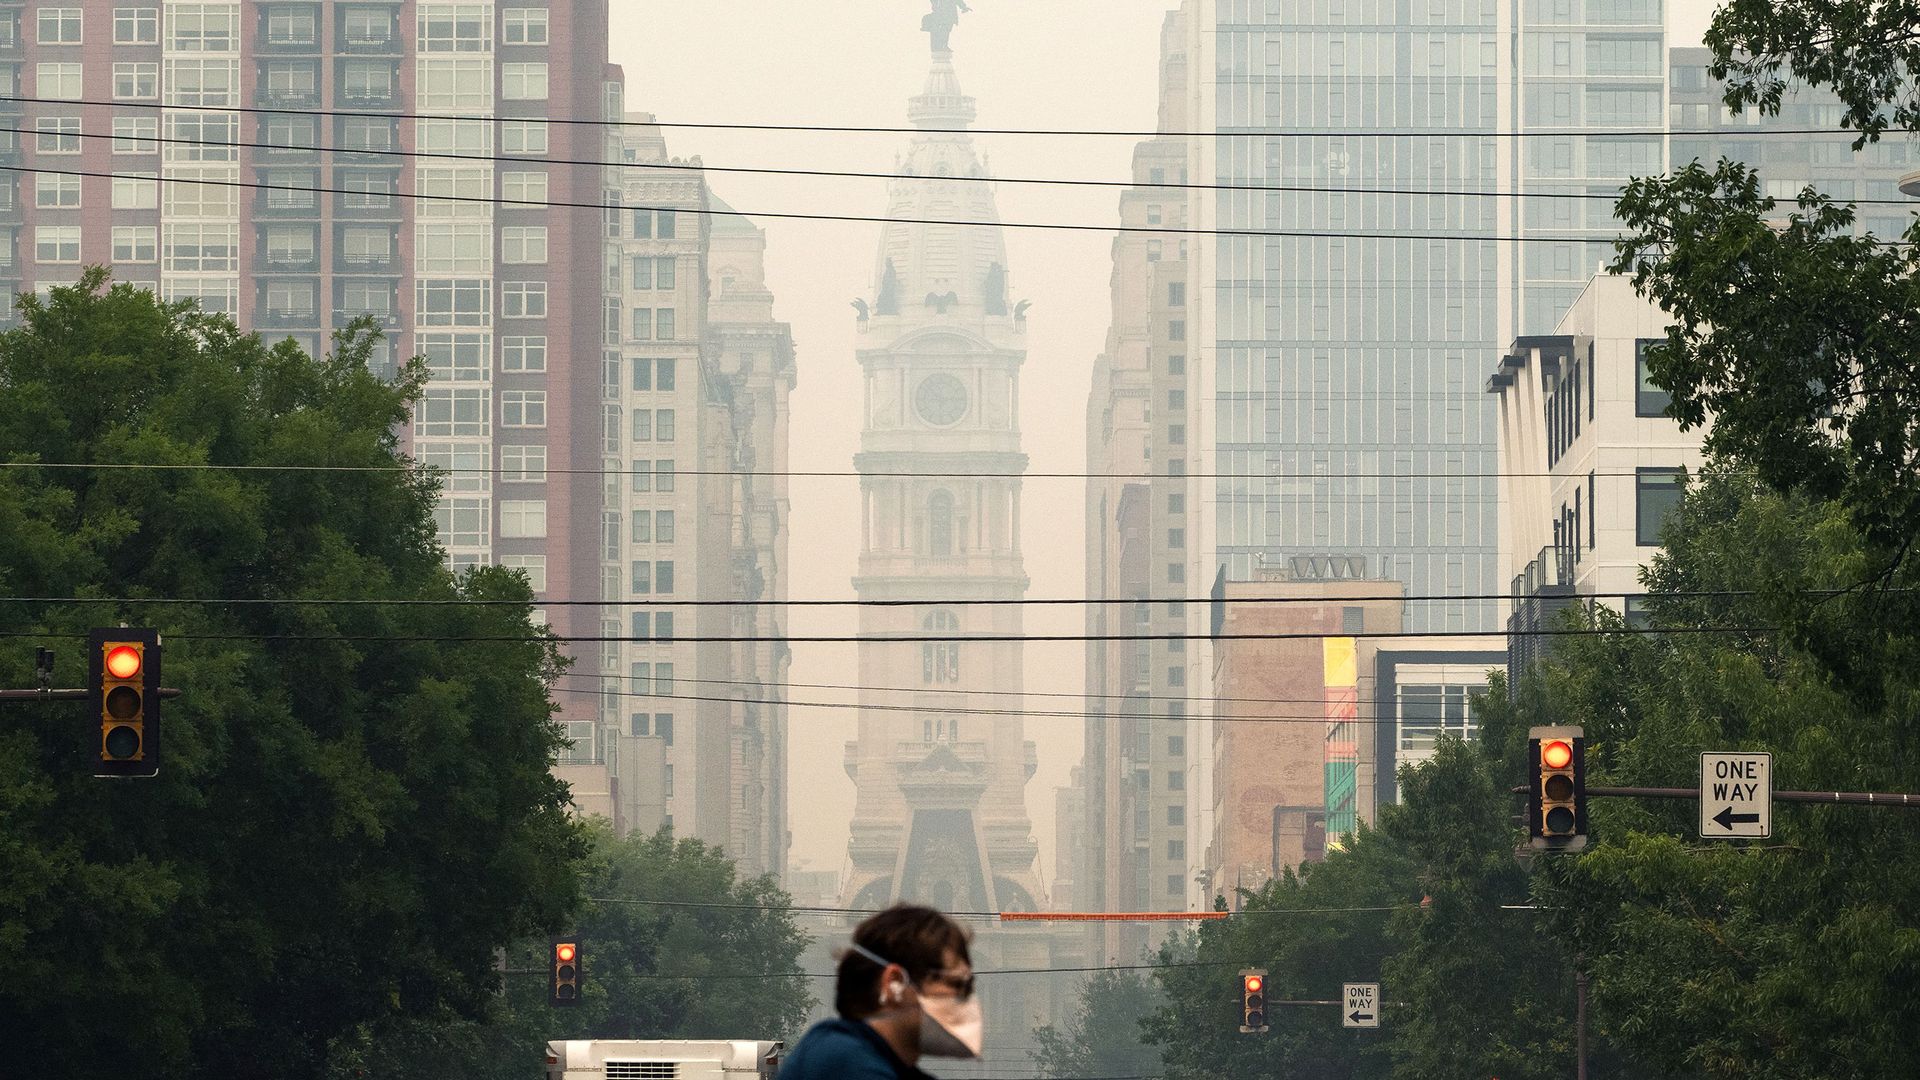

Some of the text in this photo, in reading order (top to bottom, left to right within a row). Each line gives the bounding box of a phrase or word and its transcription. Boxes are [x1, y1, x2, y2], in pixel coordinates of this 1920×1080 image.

[1716, 761, 1757, 779] ONE
[1713, 783, 1758, 801] WAY
[1350, 987, 1372, 997] ONE
[1349, 999, 1373, 1008] WAY
